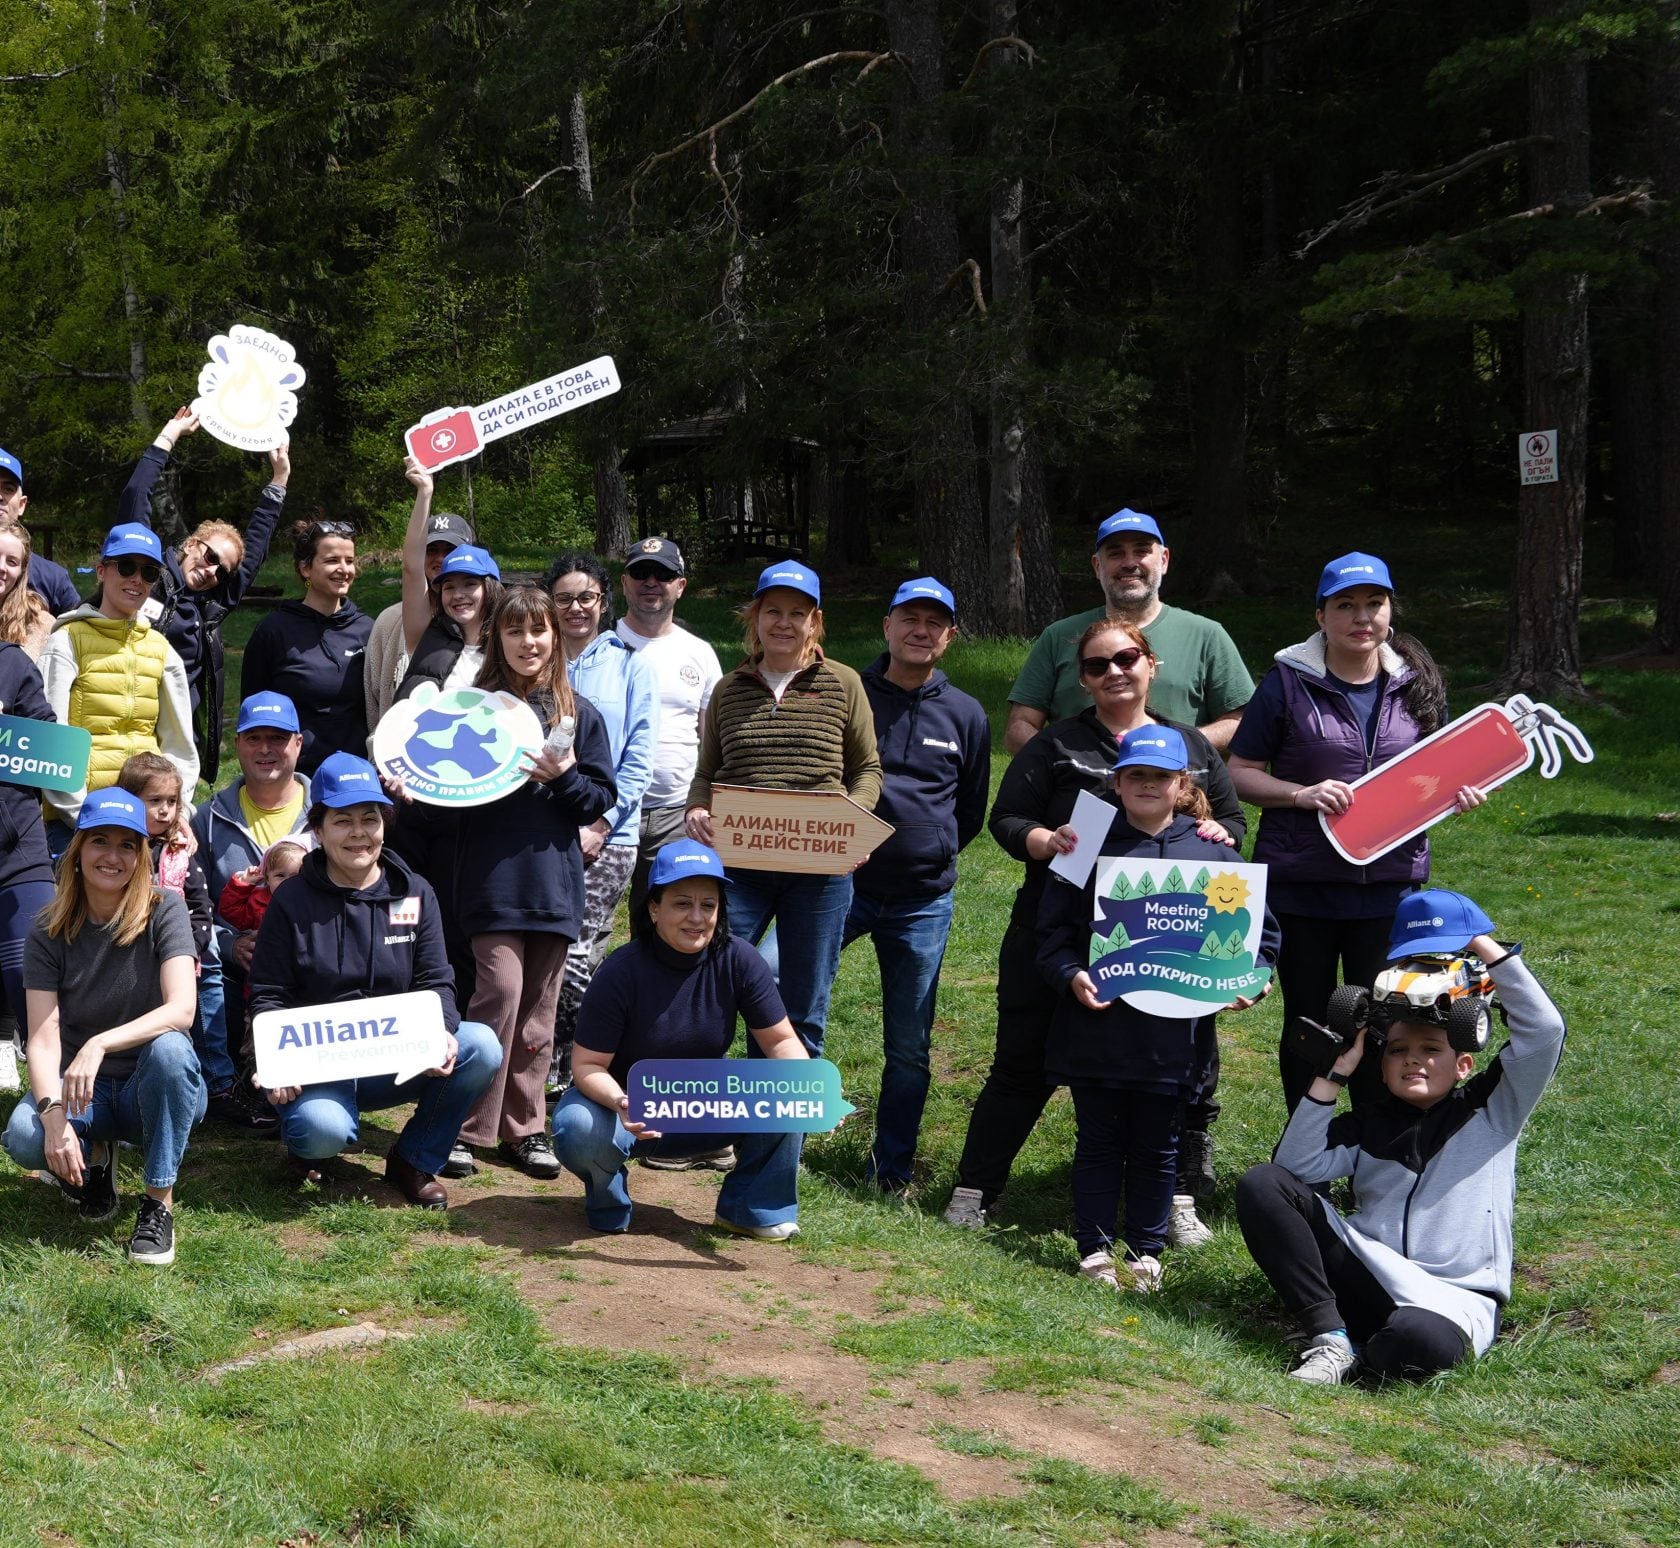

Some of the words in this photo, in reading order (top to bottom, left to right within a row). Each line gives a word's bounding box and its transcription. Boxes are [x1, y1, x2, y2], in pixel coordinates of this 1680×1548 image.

[235, 335, 288, 363] ЗАЕДНО
[478, 395, 531, 421] СИЛАТА
[533, 390, 542, 400] Е
[544, 385, 554, 395] В
[556, 370, 594, 390] ТОВА
[482, 420, 502, 436] ДА
[505, 411, 526, 425] СИ
[527, 376, 611, 417] ПОДГОТВЕН
[206, 415, 238, 440] срещу
[241, 436, 273, 445] огъня
[1527, 466, 1550, 475] ОГЪН
[1340, 566, 1364, 575] Allianz
[18, 736, 30, 750] с
[922, 738, 948, 748] Allianz
[1131, 739, 1155, 747] Allianz
[339, 774, 362, 782] Allianz
[390, 760, 437, 792] ЗАЕДНО
[438, 781, 496, 796] ПРАВИМ
[100, 801, 124, 809] Allianz
[722, 814, 801, 835] АЛИАНЦ
[806, 820, 855, 837] ЕКИП
[732, 833, 744, 846] В
[747, 833, 848, 854] ДЕЙСТВИЕ
[675, 855, 699, 863] Allianz
[1144, 902, 1209, 919] Meeting
[1146, 918, 1204, 933] ROOM:
[1406, 919, 1432, 929] Allianz
[384, 934, 410, 945] Allianz
[1098, 963, 1136, 980] ПОД
[1139, 963, 1213, 989] ОТКРИТО
[1216, 972, 1263, 990] НЕБЕ.
[278, 1016, 399, 1050] Allianz
[317, 1038, 430, 1063] Prewarning
[642, 1075, 719, 1094] Чиста
[727, 1075, 824, 1094] Витоша
[643, 1100, 750, 1118] ЗАПОЧВА
[754, 1100, 770, 1118] С
[776, 1100, 824, 1118] МЕН
